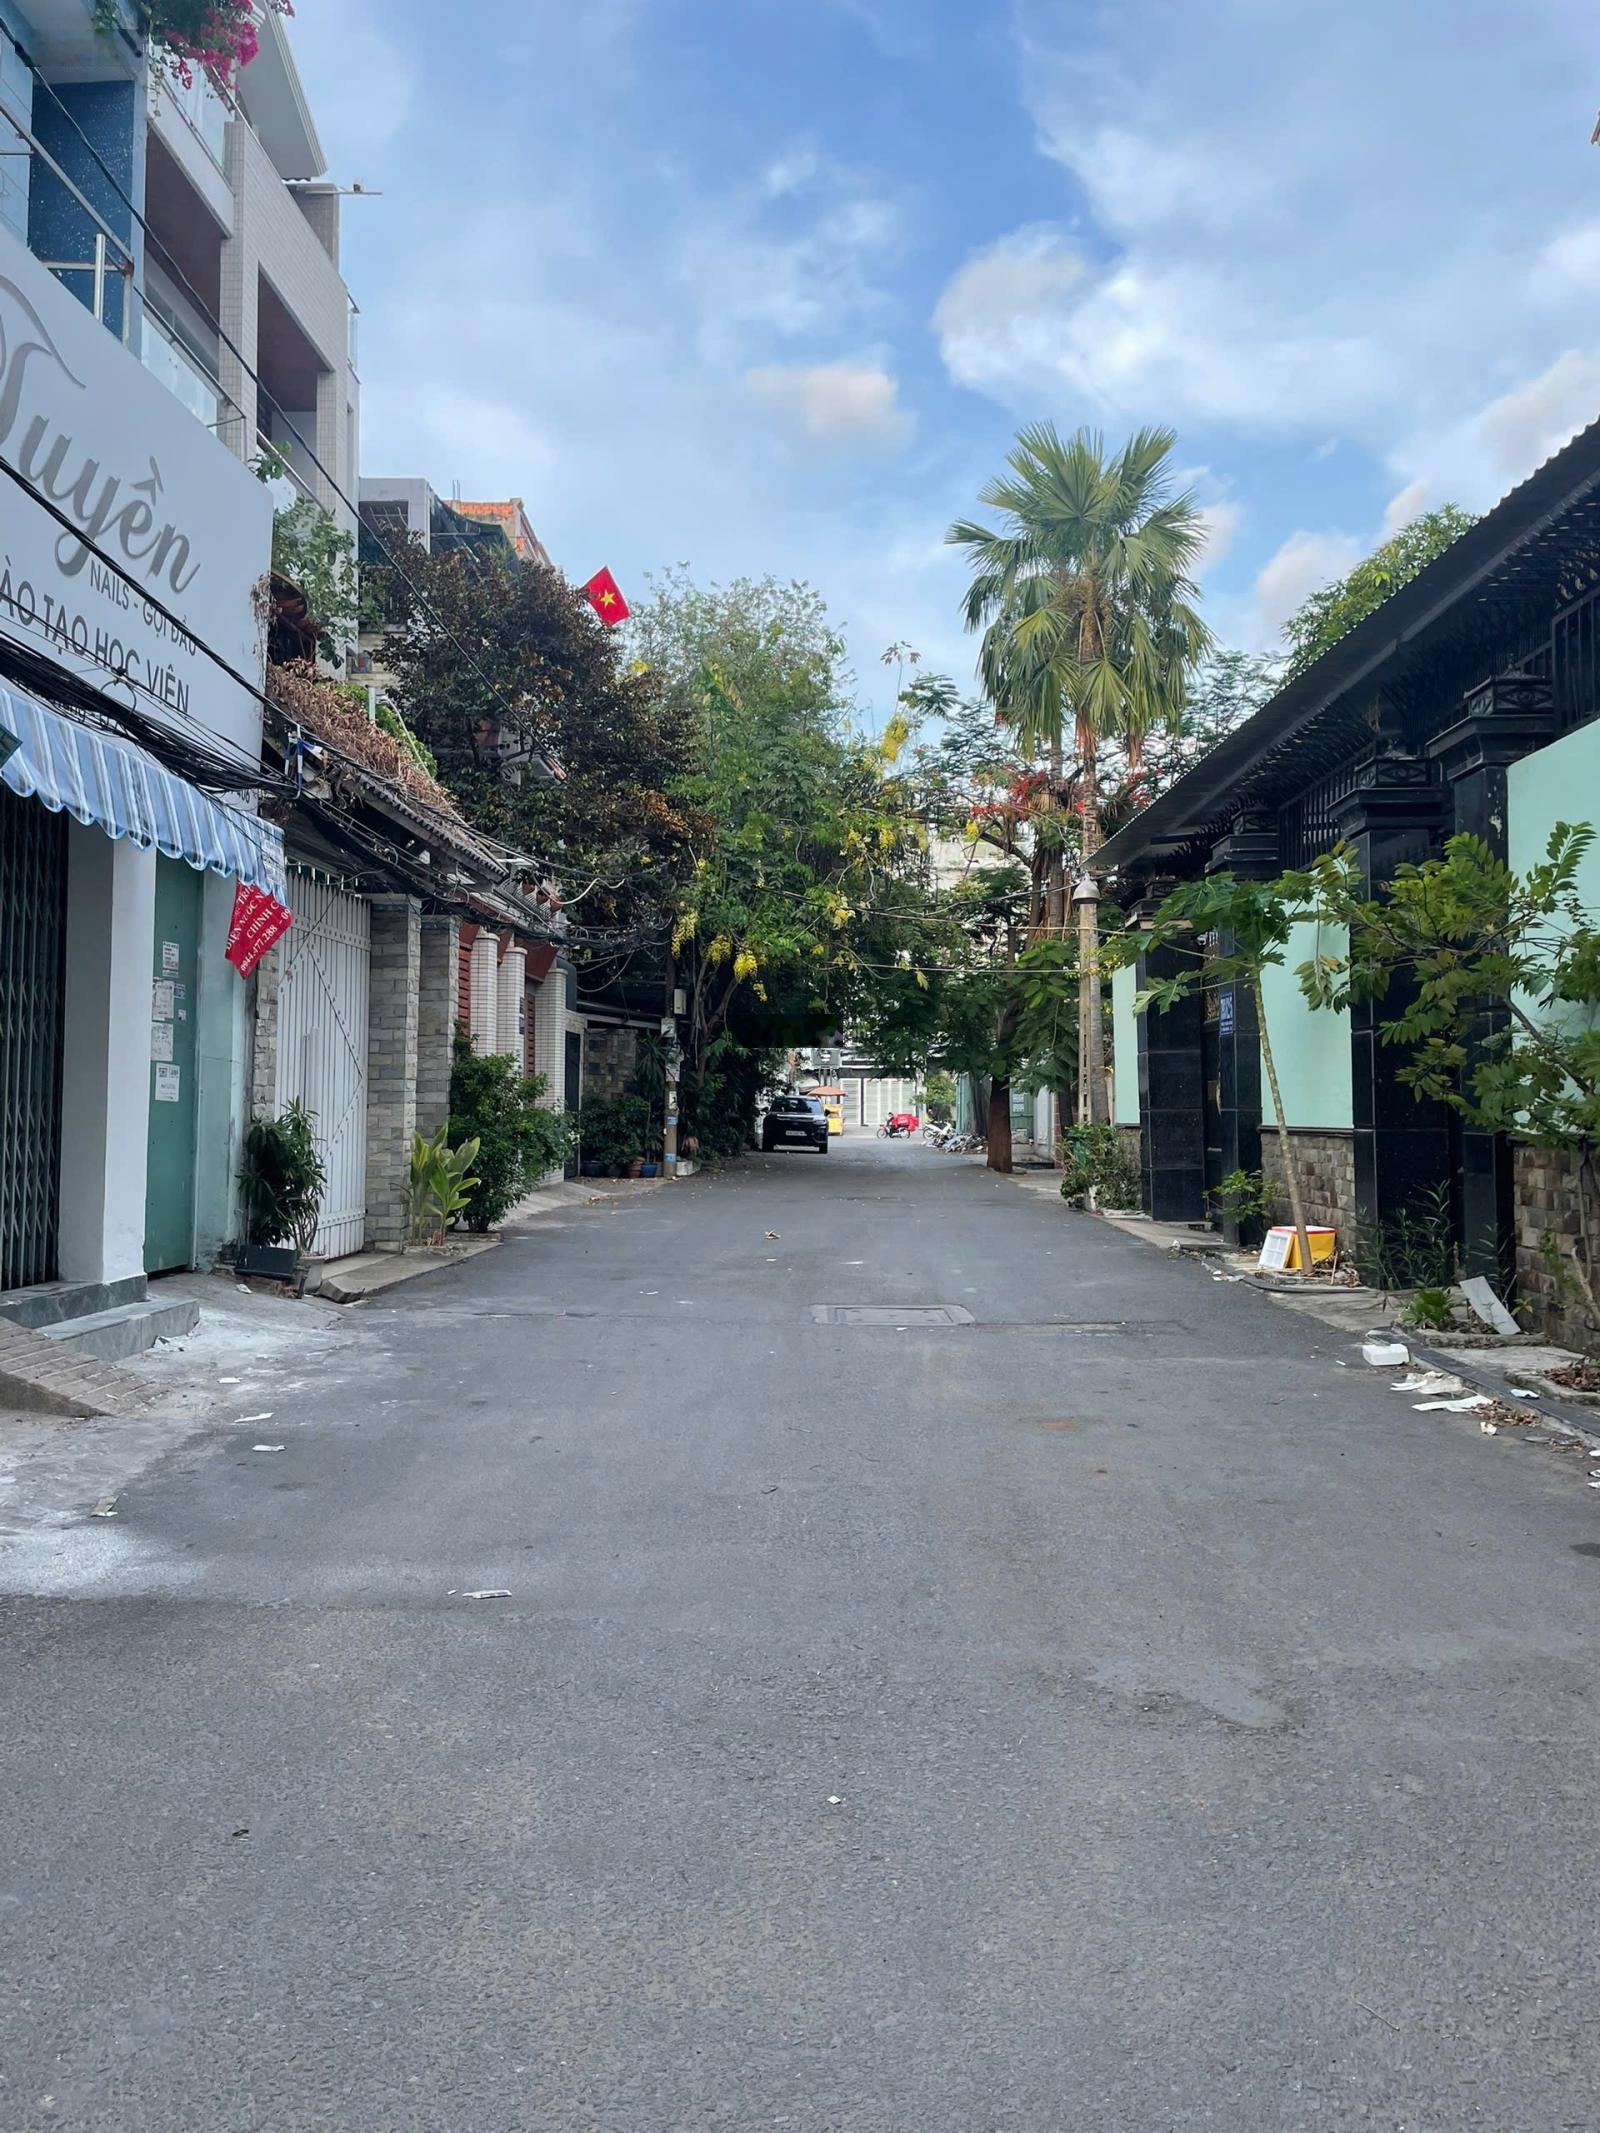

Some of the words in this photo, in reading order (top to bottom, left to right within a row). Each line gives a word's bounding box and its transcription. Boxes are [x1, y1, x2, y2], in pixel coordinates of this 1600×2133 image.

[90, 559, 129, 610] NAILS
[142, 599, 166, 638] GỌI
[44, 594, 87, 655] TẠO
[95, 627, 140, 682] HỌC
[147, 659, 189, 713] VIỆN
[246, 908, 272, 938] CHÍNH
